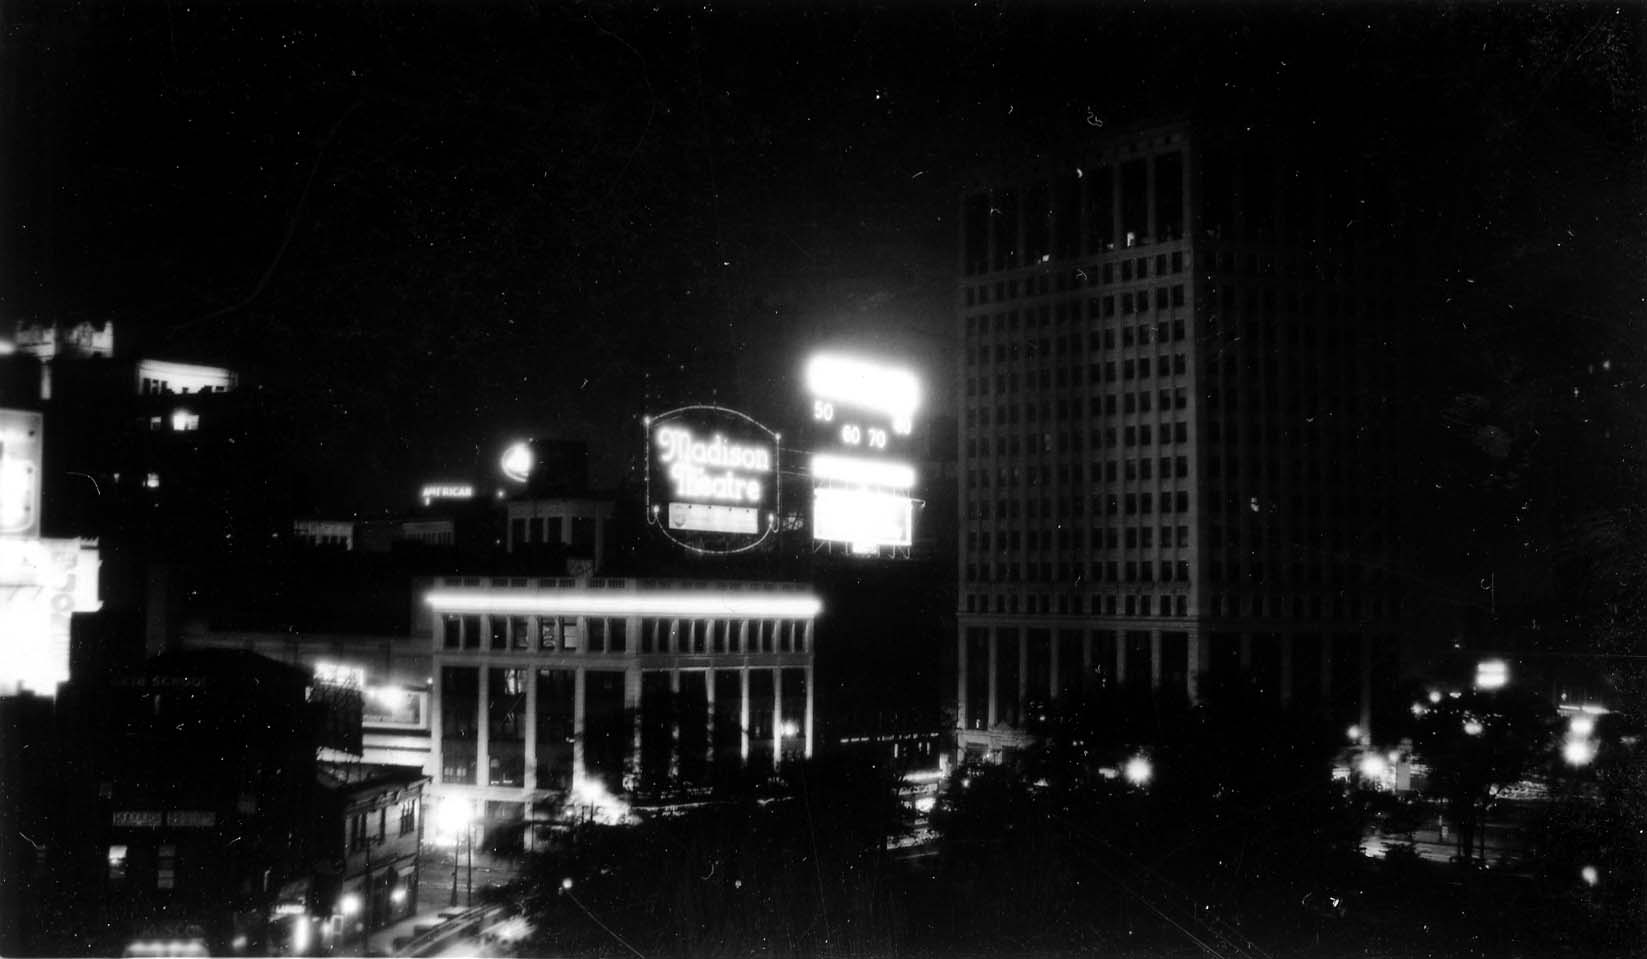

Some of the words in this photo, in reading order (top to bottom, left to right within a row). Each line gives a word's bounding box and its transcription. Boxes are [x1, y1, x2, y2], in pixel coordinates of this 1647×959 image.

[814, 400, 834, 421] 50
[842, 424, 861, 444] 60
[868, 427, 886, 449] 70
[658, 427, 770, 472] Madison
[671, 464, 760, 501] Theatre
